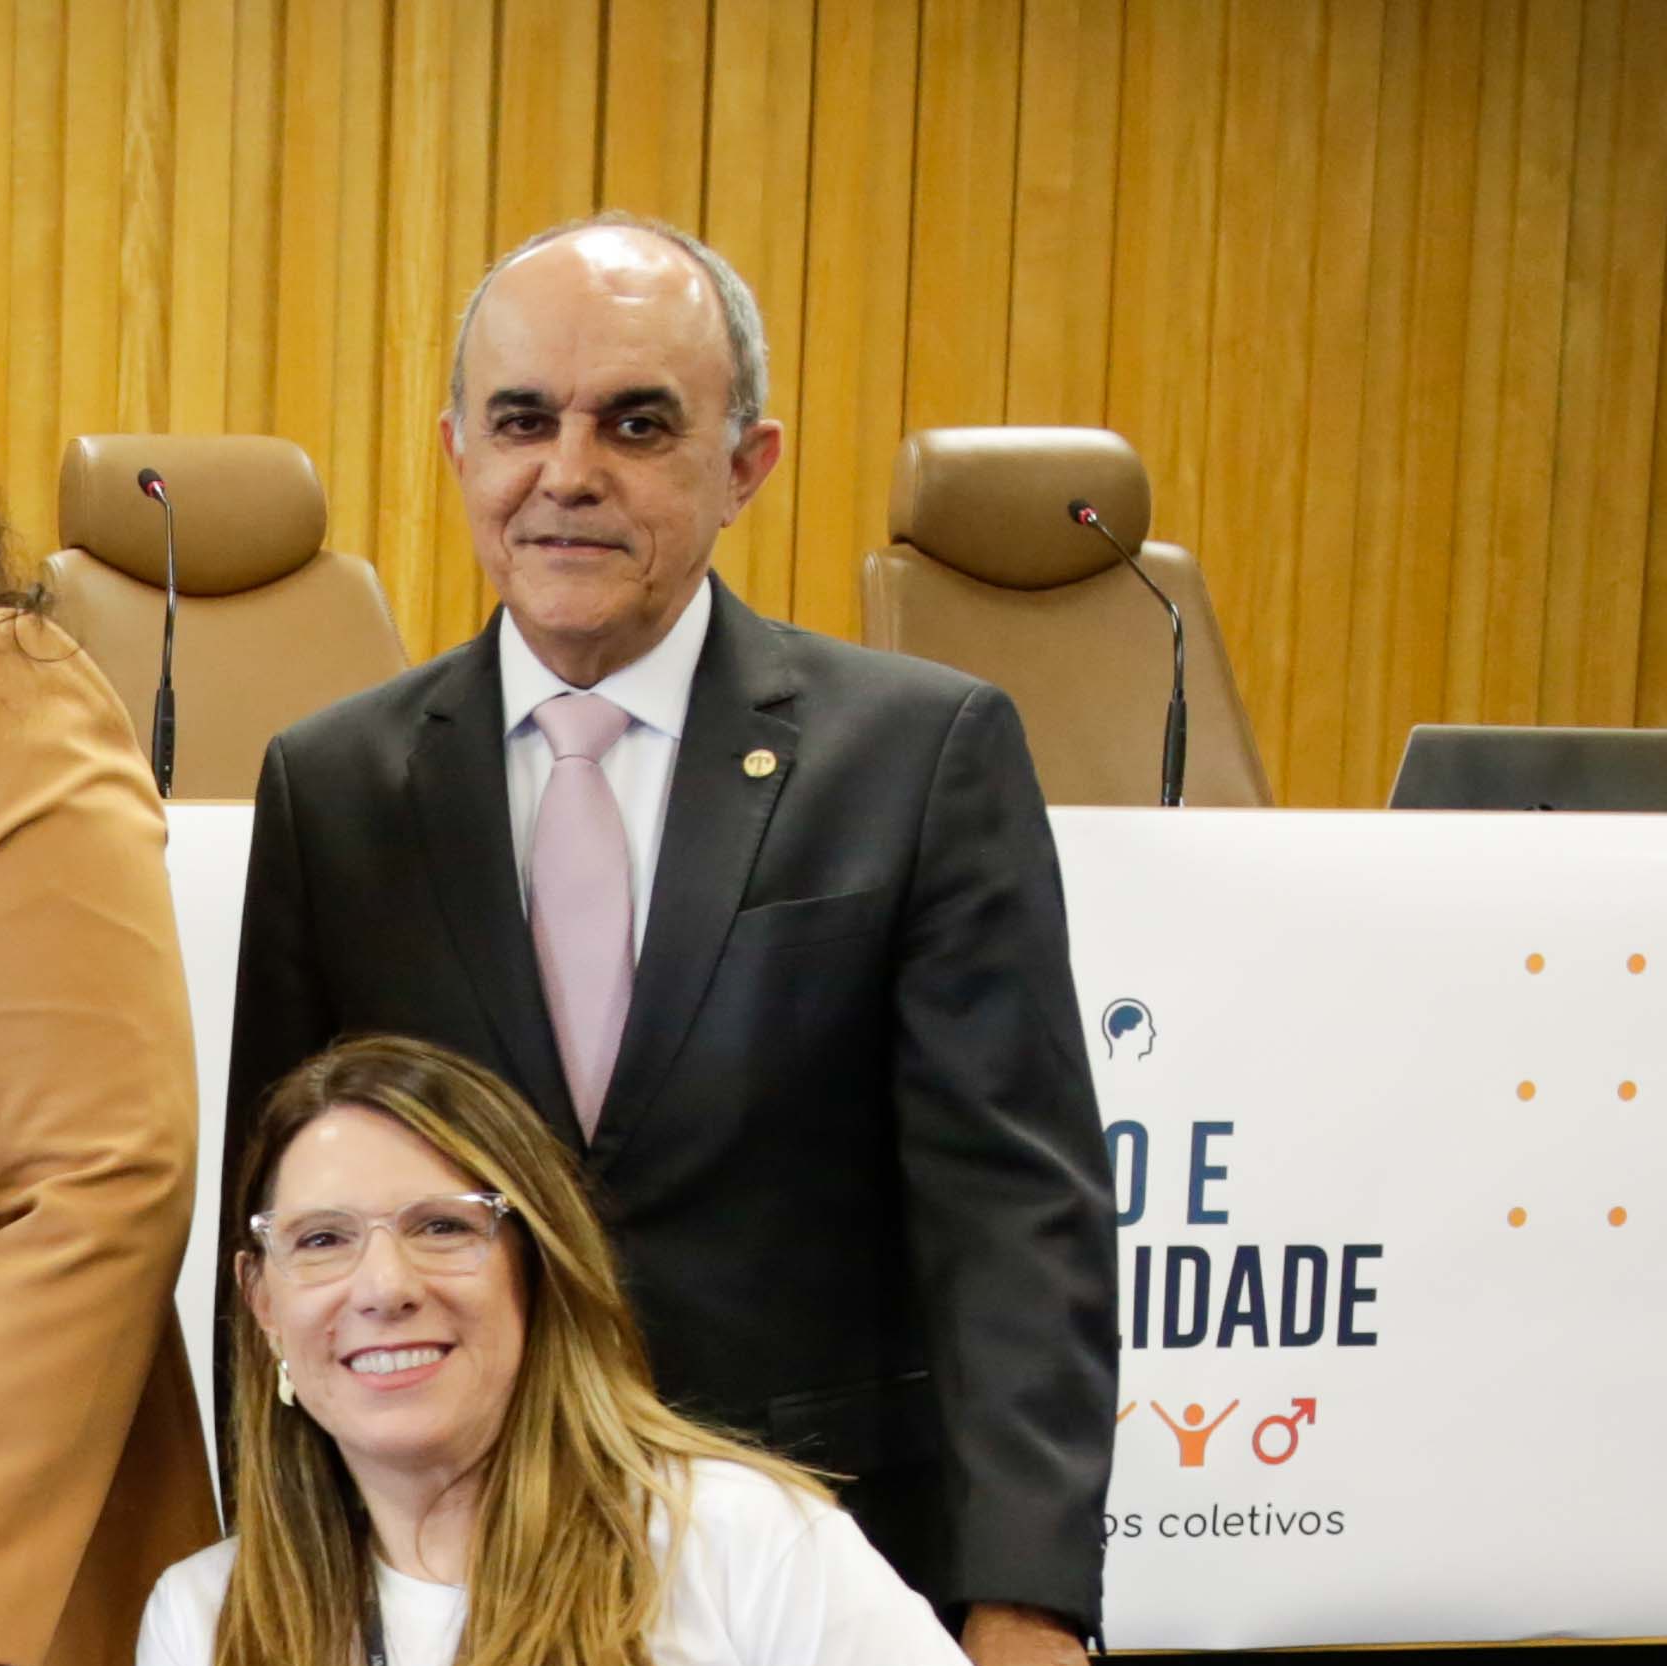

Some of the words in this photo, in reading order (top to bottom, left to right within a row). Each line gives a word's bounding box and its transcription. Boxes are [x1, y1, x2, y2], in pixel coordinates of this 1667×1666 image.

[1186, 1120, 1235, 1225] E
[1119, 1243, 1384, 1350] IDADE
[1158, 1503, 1345, 1538] coletivos
